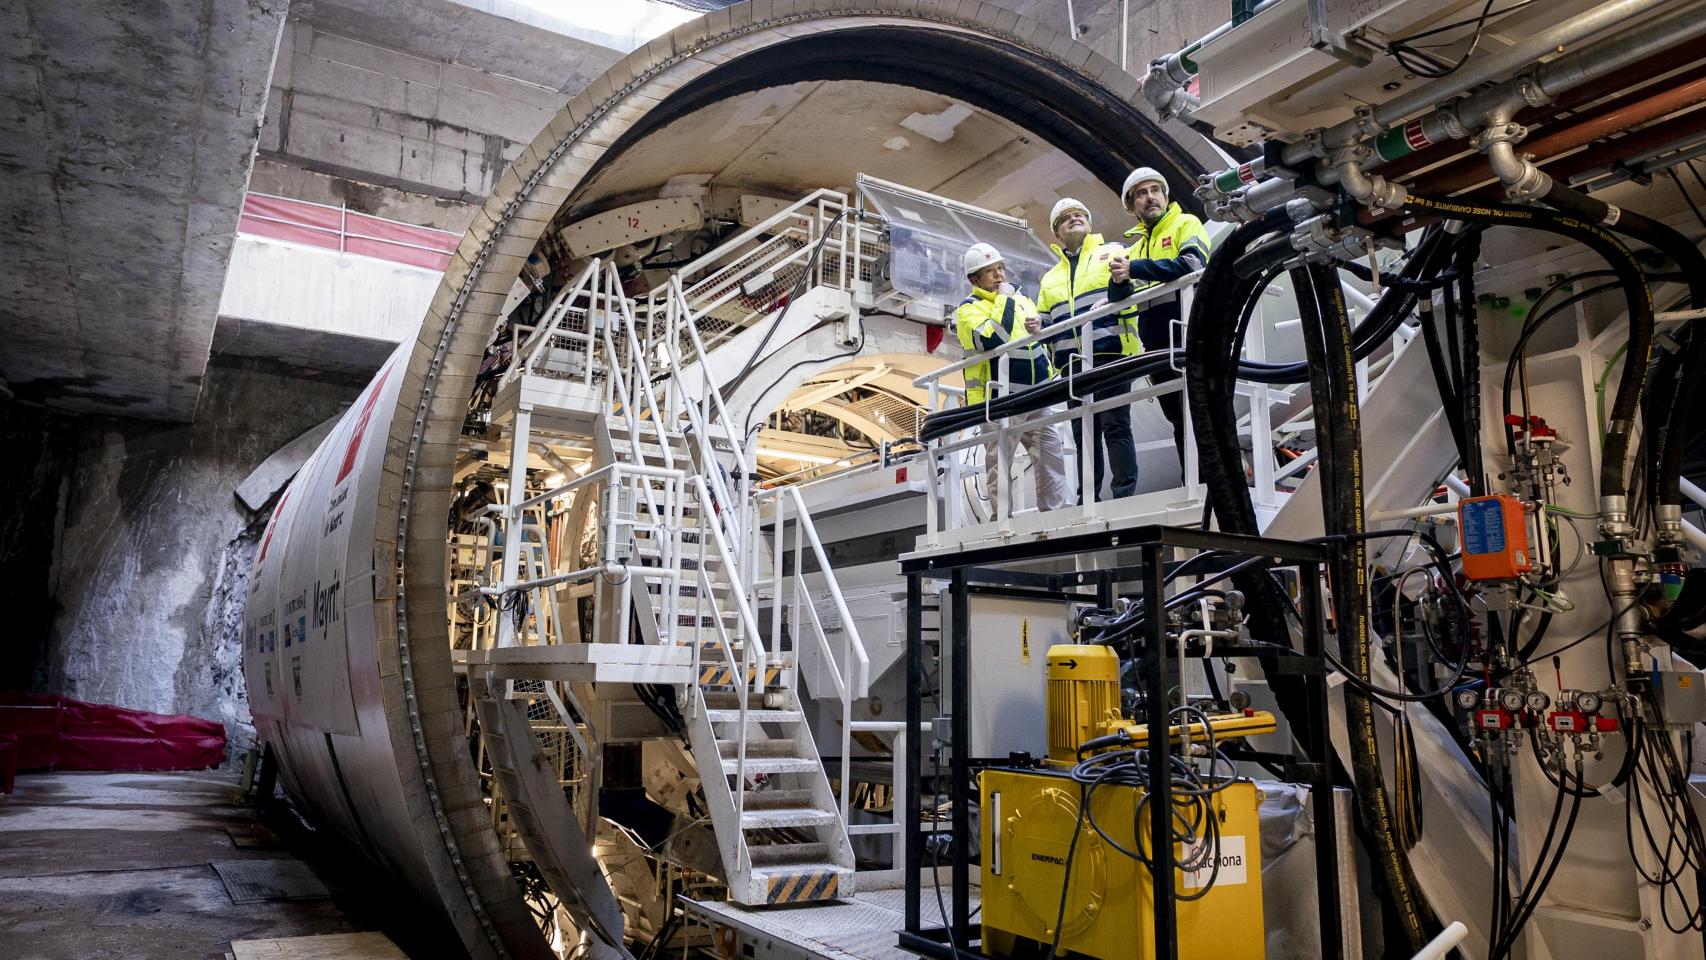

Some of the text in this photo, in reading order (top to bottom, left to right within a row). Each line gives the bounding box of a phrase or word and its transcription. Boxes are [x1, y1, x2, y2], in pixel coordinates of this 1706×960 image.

[1472, 207, 1491, 216] HOSE
[628, 217, 639, 228] 12
[1384, 830, 1394, 851] HOSE
[1032, 853, 1064, 865] ENERPAC
[1201, 853, 1242, 868] aciona
